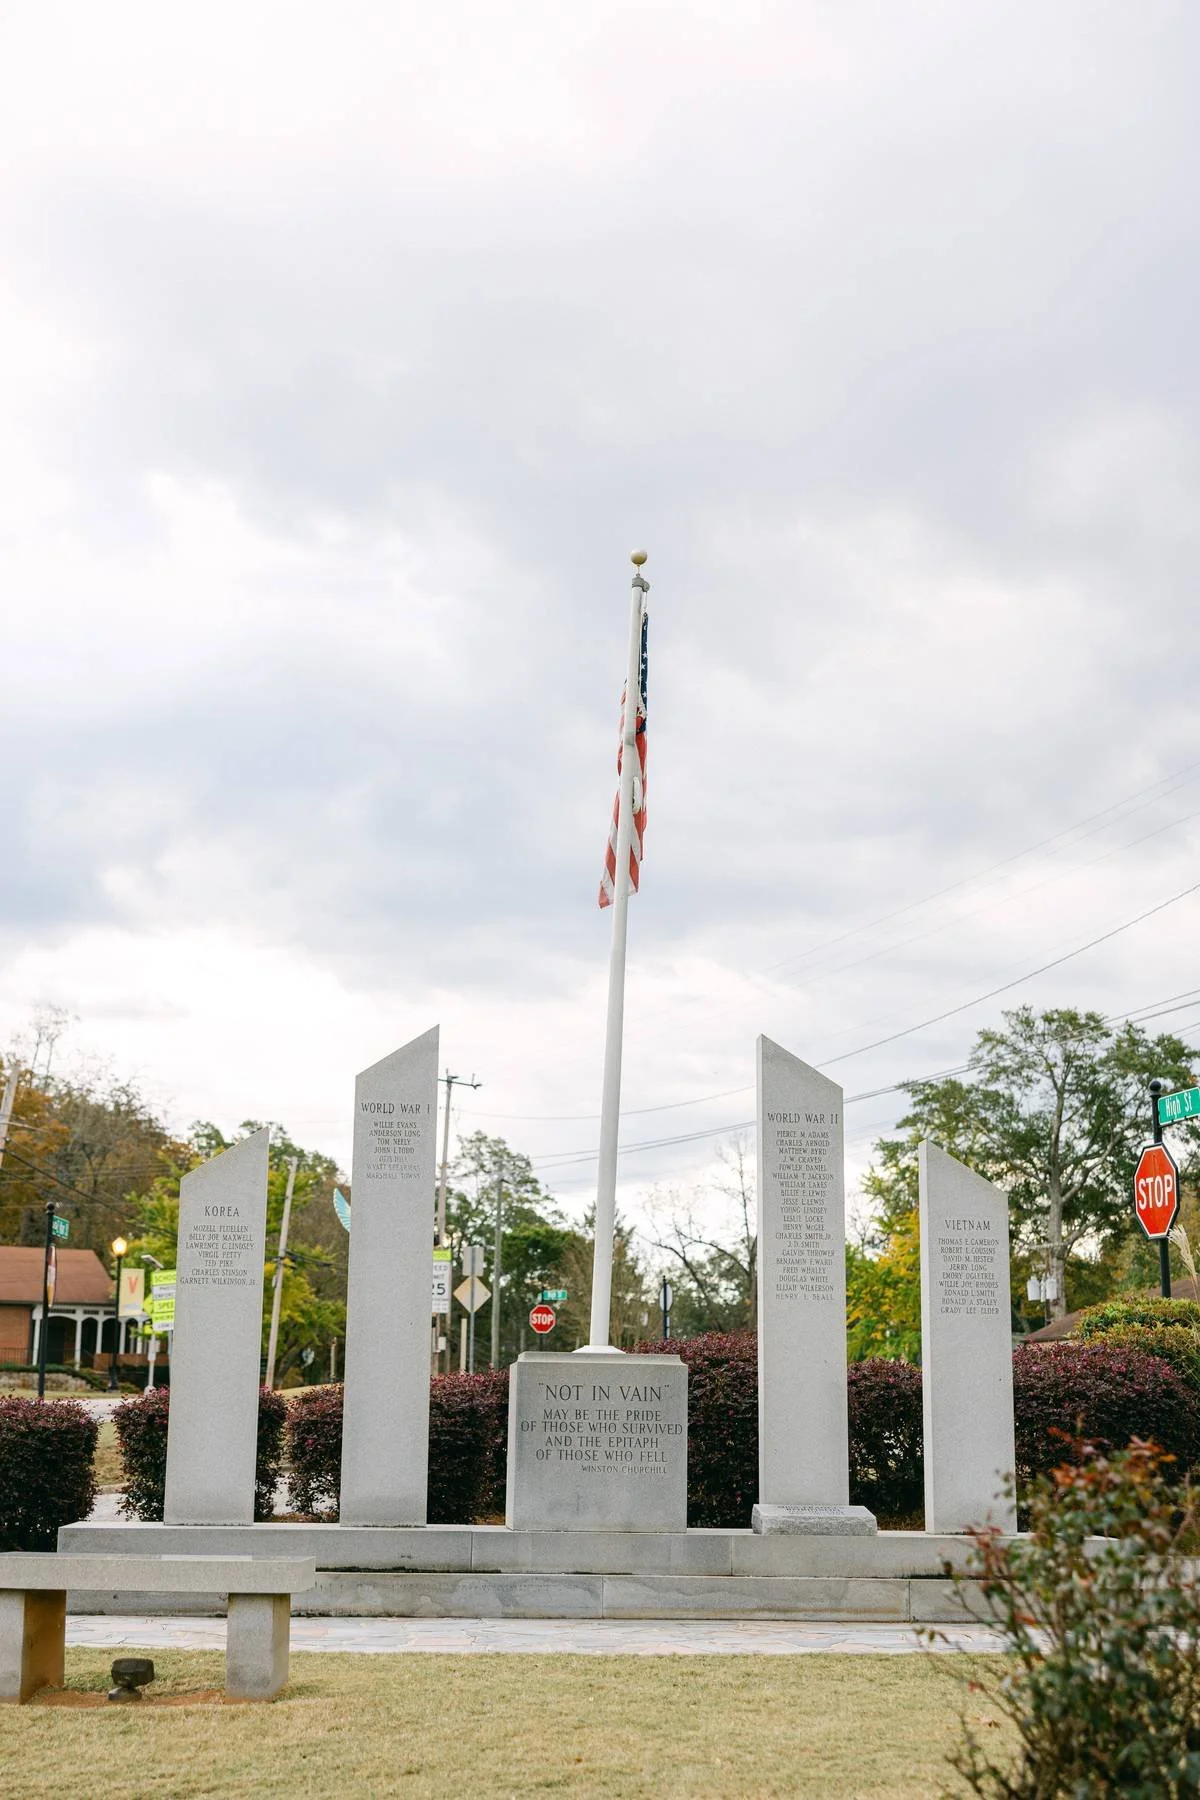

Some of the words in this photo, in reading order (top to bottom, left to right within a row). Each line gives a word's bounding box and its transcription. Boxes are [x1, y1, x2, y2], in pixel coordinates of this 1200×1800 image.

[361, 1102, 394, 1113] WORLD
[400, 1103, 420, 1114] WAR
[427, 1104, 430, 1114] I
[1166, 1096, 1181, 1118] High
[1184, 1092, 1192, 1112] St
[768, 1113, 800, 1123] WORLD
[805, 1113, 824, 1123] WAR
[831, 1114, 838, 1124] II
[1138, 1174, 1172, 1210] STOP
[205, 1206, 240, 1216] KOREA
[945, 1220, 991, 1230] VIETNAM
[532, 1313, 553, 1325] STOP
[538, 1383, 583, 1401] "NOT
[593, 1386, 610, 1400] IN
[619, 1384, 669, 1401] VAIN"
[544, 1409, 568, 1420] MAY
[575, 1410, 589, 1420] BE
[596, 1410, 619, 1420] THE
[626, 1410, 662, 1421] PRIDE
[520, 1421, 537, 1432] OF
[542, 1421, 583, 1433] THOSE
[589, 1422, 616, 1433] WHO
[622, 1423, 683, 1435] SURVIVED
[545, 1436, 572, 1447] AND
[578, 1436, 600, 1447] THE
[609, 1437, 658, 1448] EPITAPH
[536, 1450, 551, 1460] OF
[558, 1450, 599, 1461] THOSE
[605, 1451, 633, 1461] WHO
[622, 1466, 667, 1474] CHURCHILL
